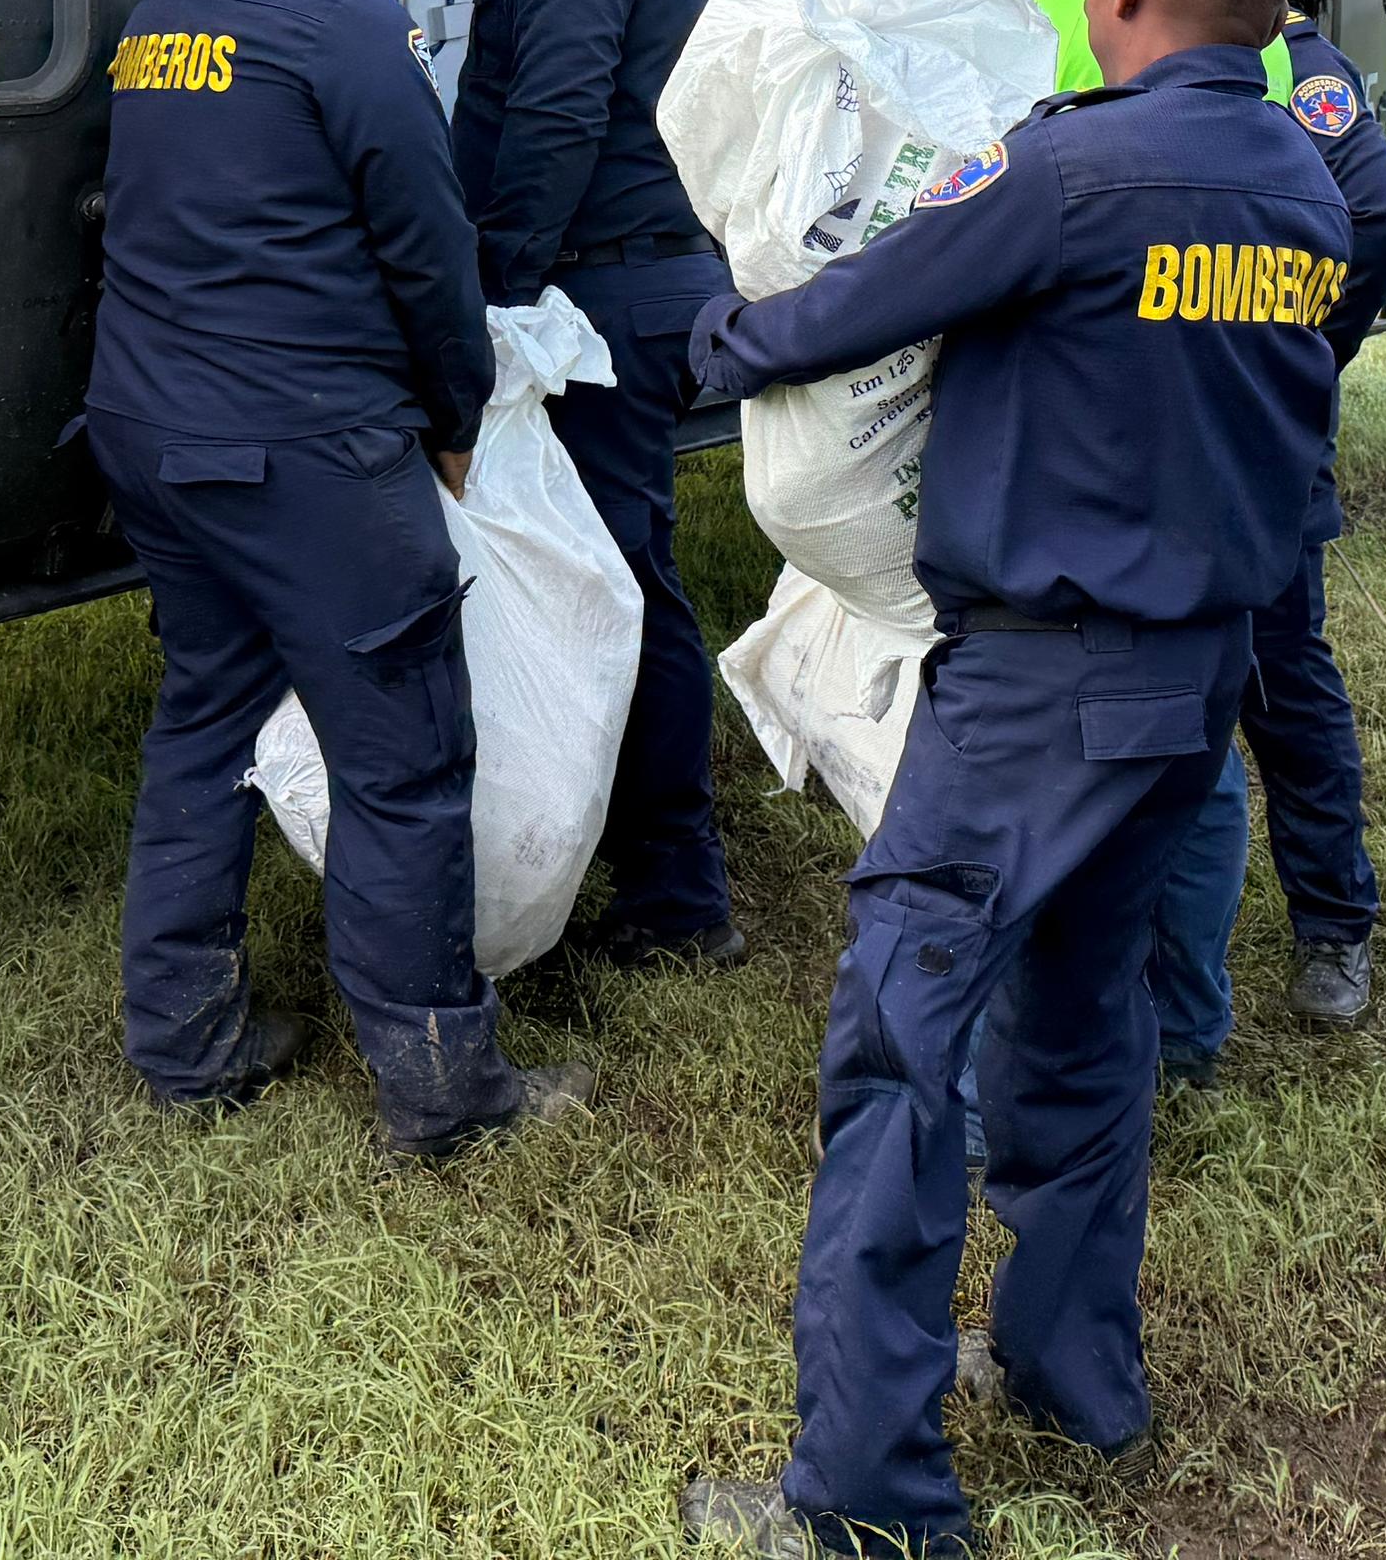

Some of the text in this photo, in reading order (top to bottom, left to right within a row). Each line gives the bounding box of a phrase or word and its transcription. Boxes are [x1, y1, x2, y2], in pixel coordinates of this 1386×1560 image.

[1137, 243, 1348, 327] BOMBEROS
[848, 374, 884, 399] Km
[889, 349, 916, 380] 125
